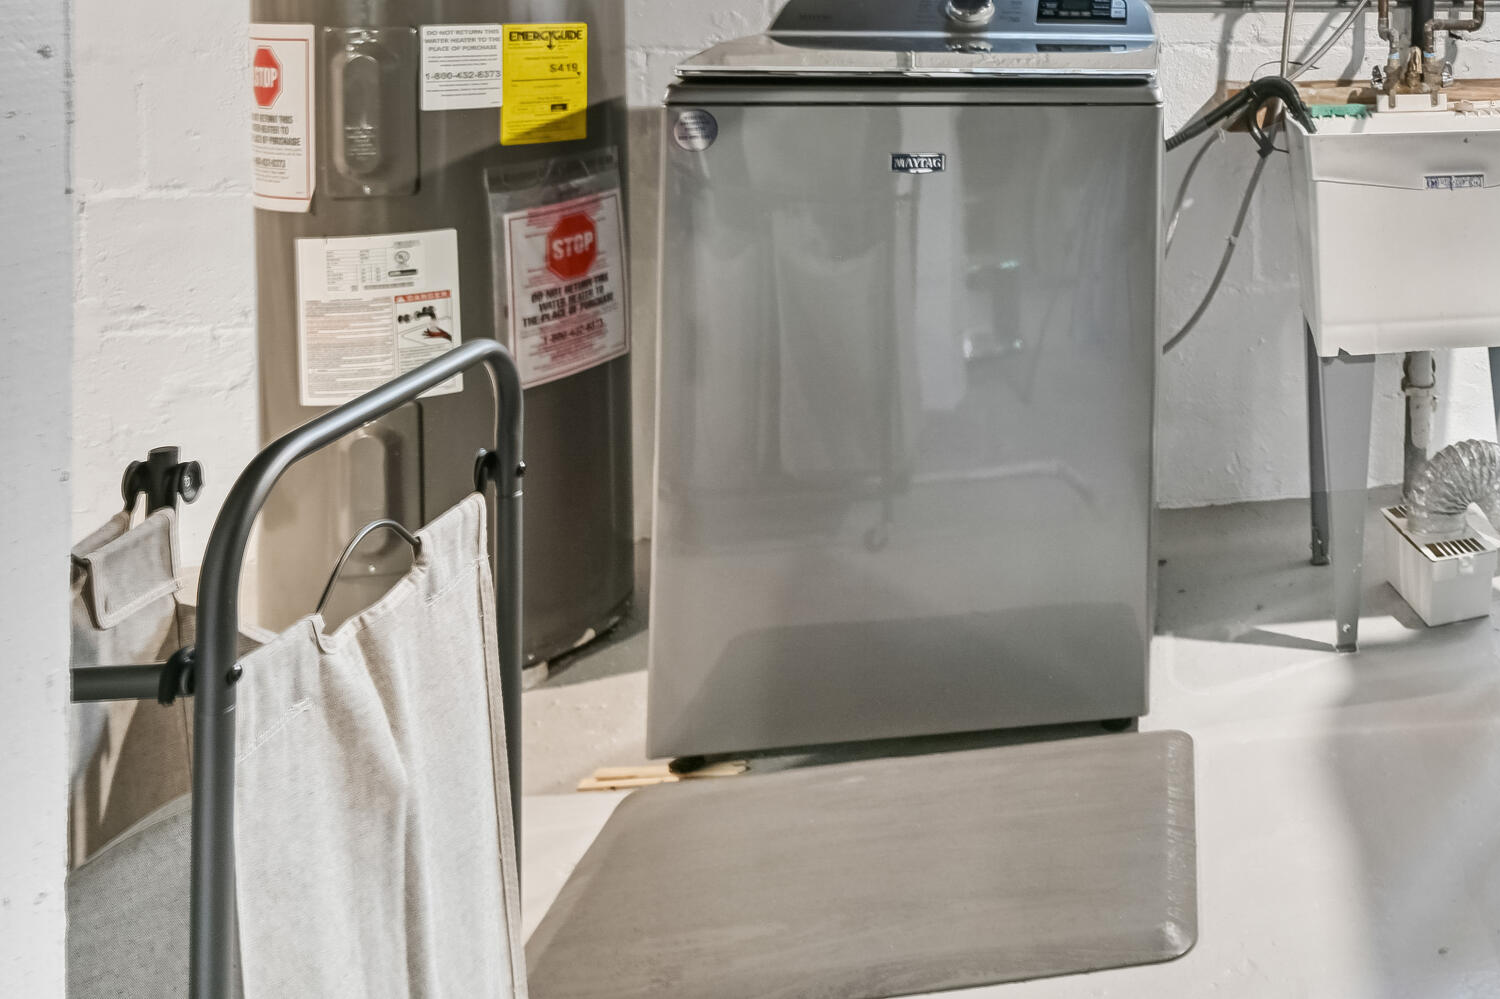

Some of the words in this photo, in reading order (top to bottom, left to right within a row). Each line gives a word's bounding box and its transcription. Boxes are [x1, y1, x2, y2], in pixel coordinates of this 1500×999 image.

[894, 157, 942, 168] MAYTAG
[552, 231, 594, 260] STOP
[523, 315, 538, 328] THE
